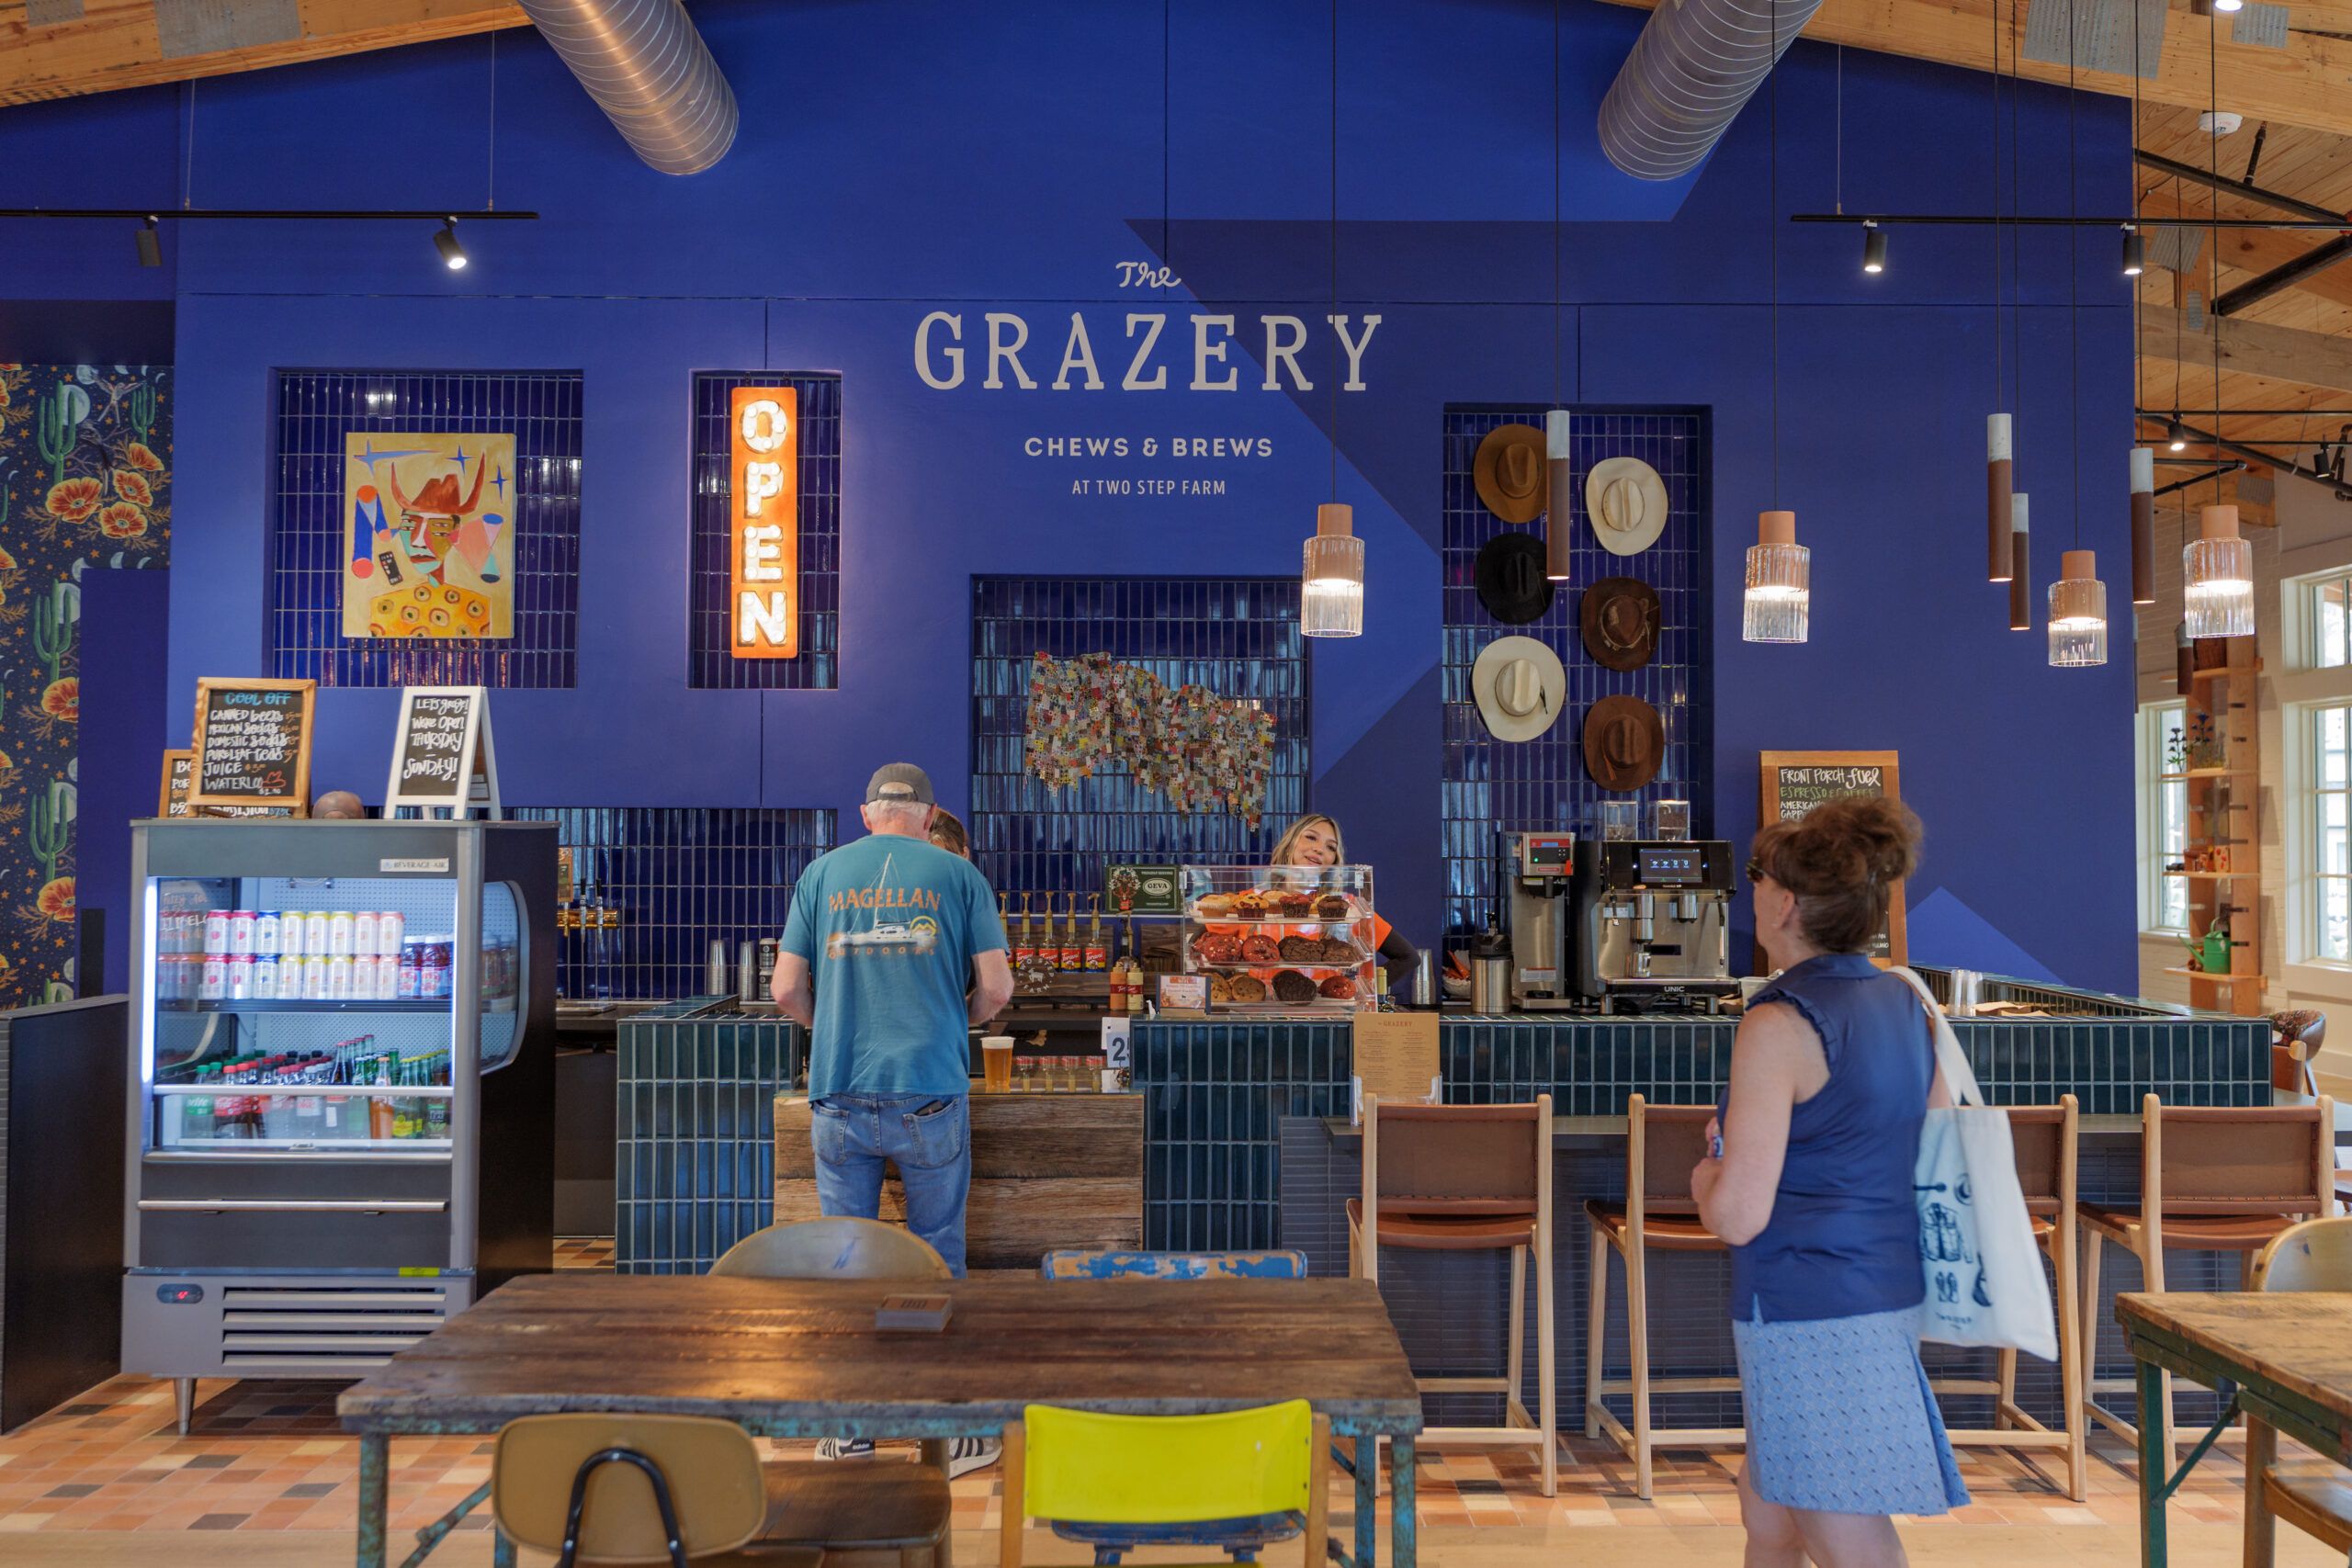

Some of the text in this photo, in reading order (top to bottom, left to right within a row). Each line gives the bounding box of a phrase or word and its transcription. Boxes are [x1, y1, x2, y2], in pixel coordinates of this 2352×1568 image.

[1115, 262, 1182, 288] The
[914, 311, 1382, 391] GRAZERY
[1024, 437, 1273, 457] CHEWS & BREWS
[1072, 479, 1226, 495] AT TWO STEP FARM
[738, 399, 787, 647] OPEN
[207, 735, 249, 749] DOMESTIC
[410, 731, 464, 752] THURSDAY
[1780, 768, 1813, 784] FRONT
[1814, 768, 1846, 784] PORCH
[1780, 786, 1827, 801] ESPRESSO
[829, 887, 941, 914] MAGELLAN
[828, 945, 935, 960] OUTDOORS
